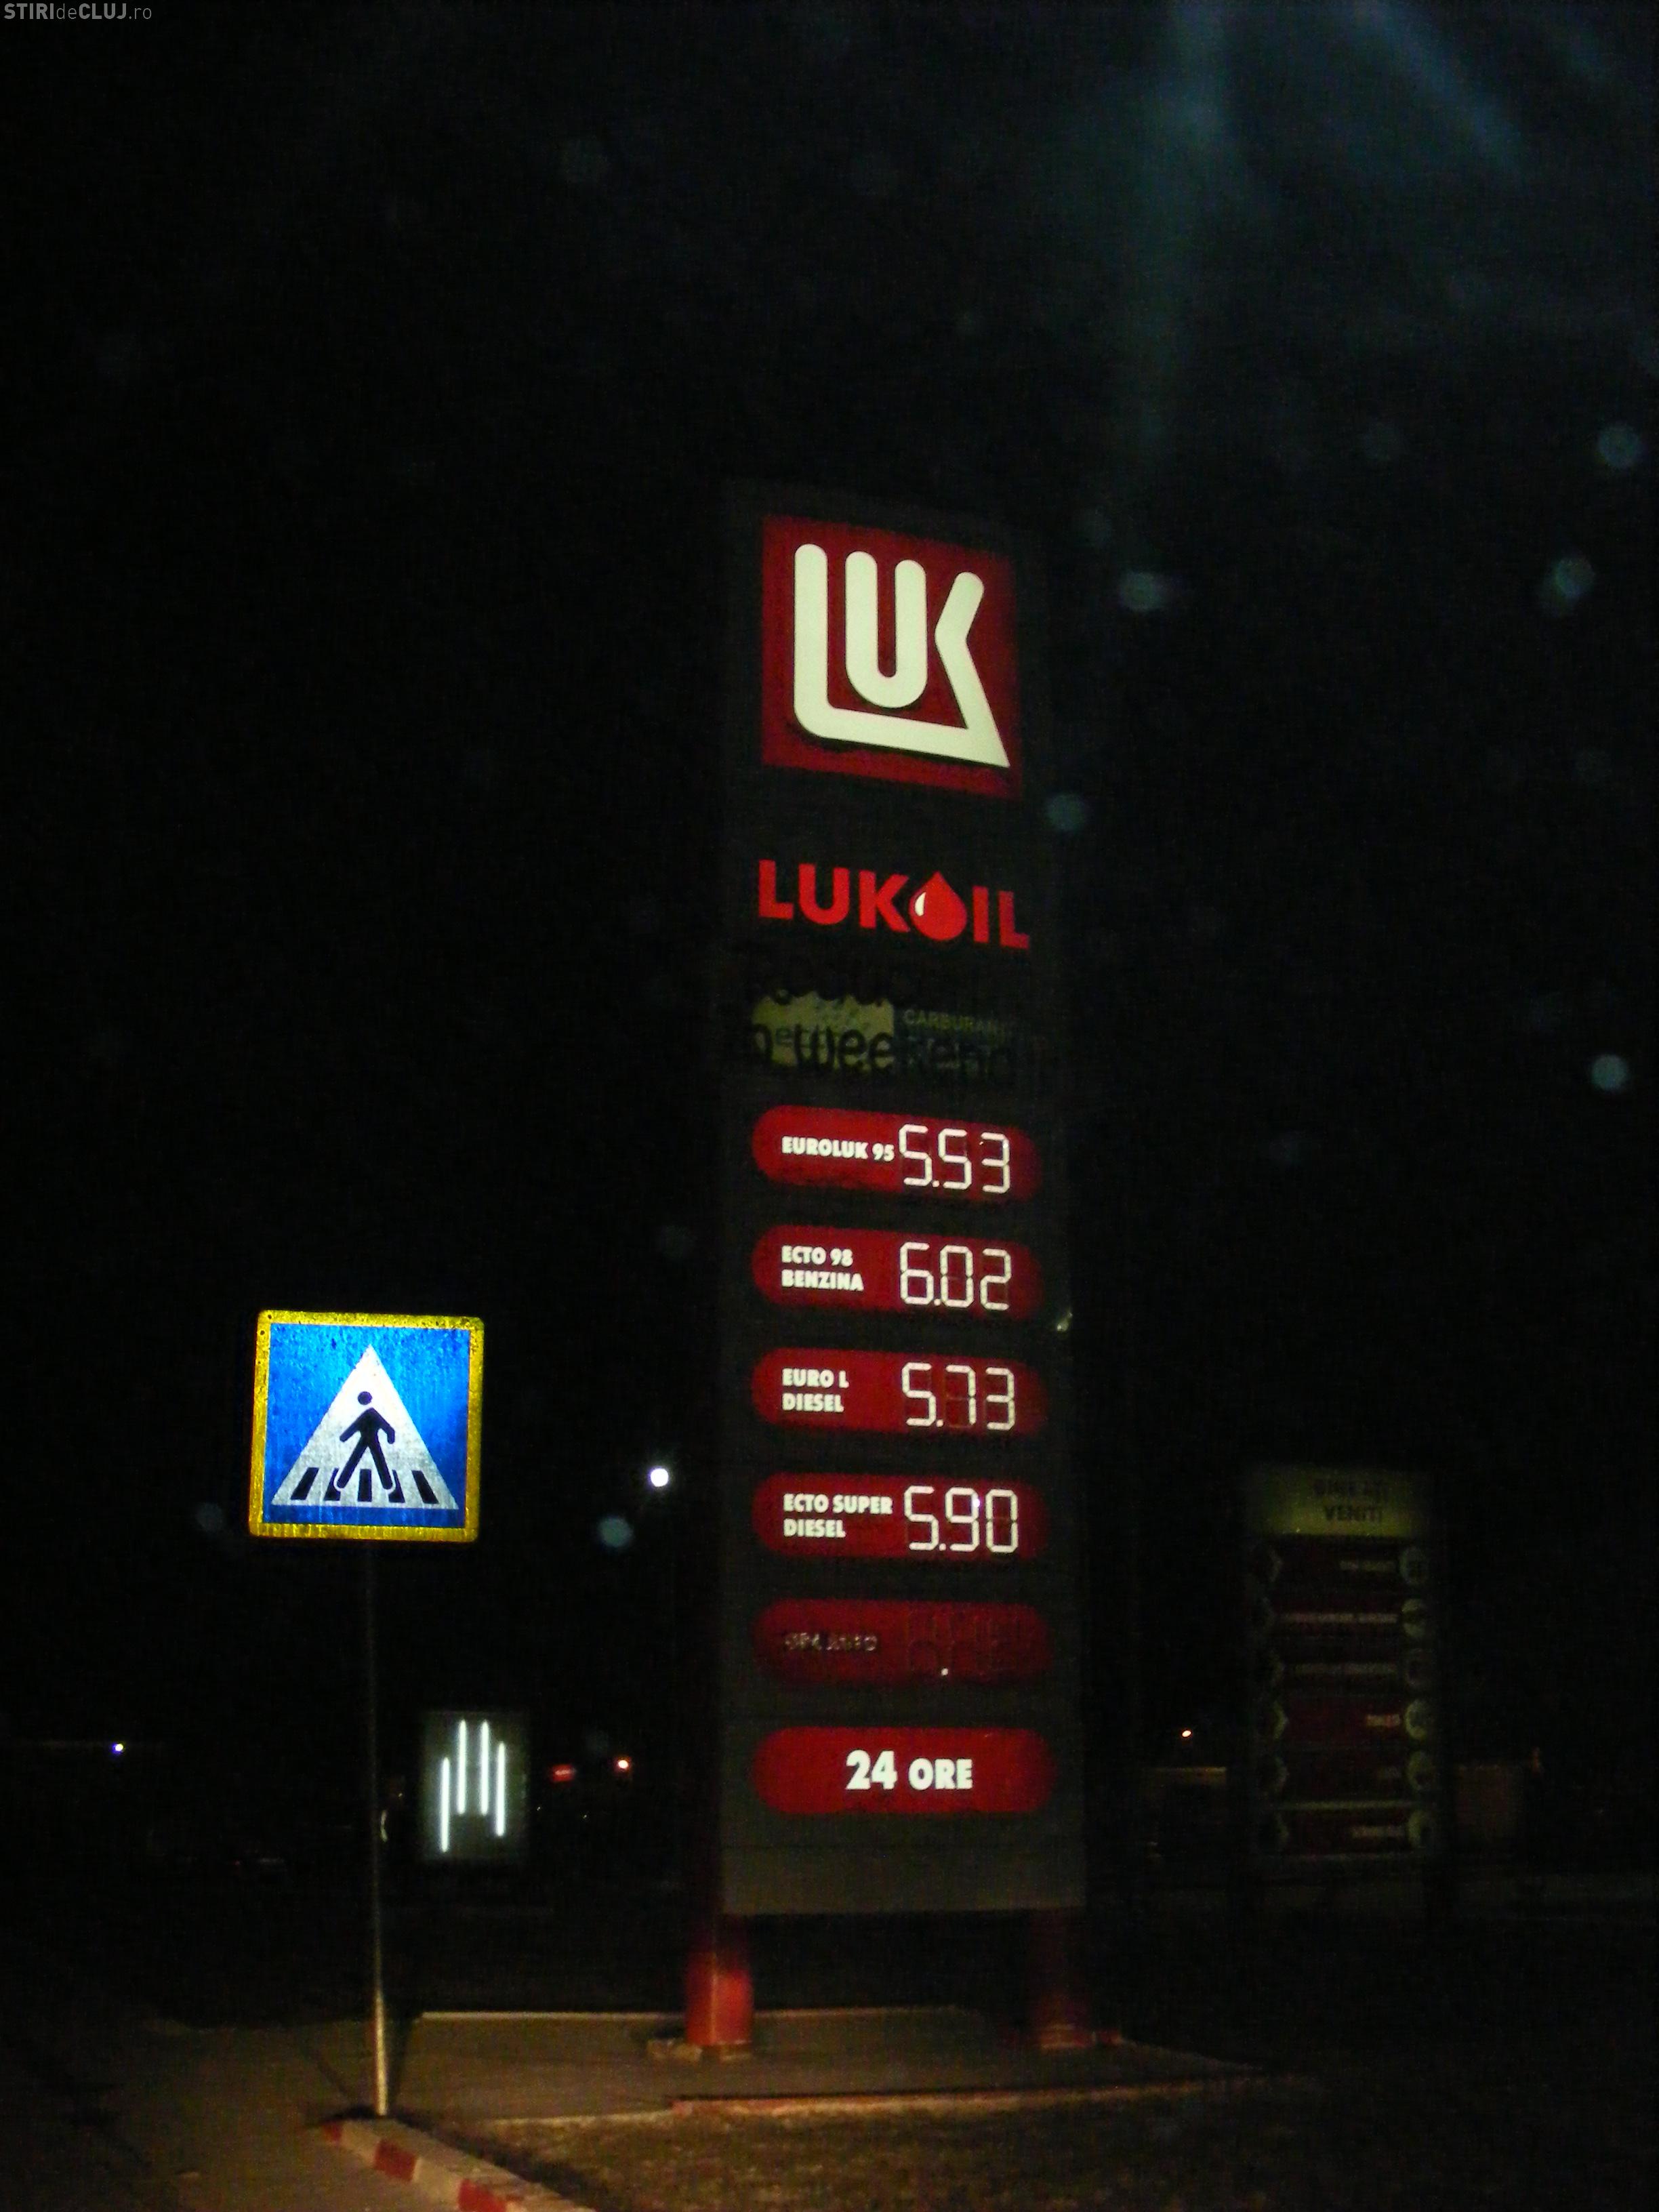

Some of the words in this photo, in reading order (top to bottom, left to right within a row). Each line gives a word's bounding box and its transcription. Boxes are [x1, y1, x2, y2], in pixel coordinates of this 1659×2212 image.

[758, 859, 1029, 949] LUKOIL
[781, 1136, 869, 1160] EUROLUK
[872, 1143, 895, 1162] 95
[898, 1124, 1010, 1193] 5.53
[781, 1245, 827, 1265] ECTO
[830, 1248, 853, 1267] 98
[781, 1269, 864, 1291] BENZINA
[899, 1242, 1012, 1311] 6.02
[782, 1368, 835, 1388] EURO
[838, 1370, 849, 1389] L
[782, 1393, 844, 1412] DIESEL
[901, 1362, 1015, 1430] 5.73
[783, 1493, 830, 1513] ECTO
[832, 1494, 893, 1515] SUPER
[783, 1518, 846, 1538] DIESEL
[903, 1485, 1019, 1553] 5.90
[845, 1749, 898, 1790] 24
[908, 1758, 973, 1790] ORE
